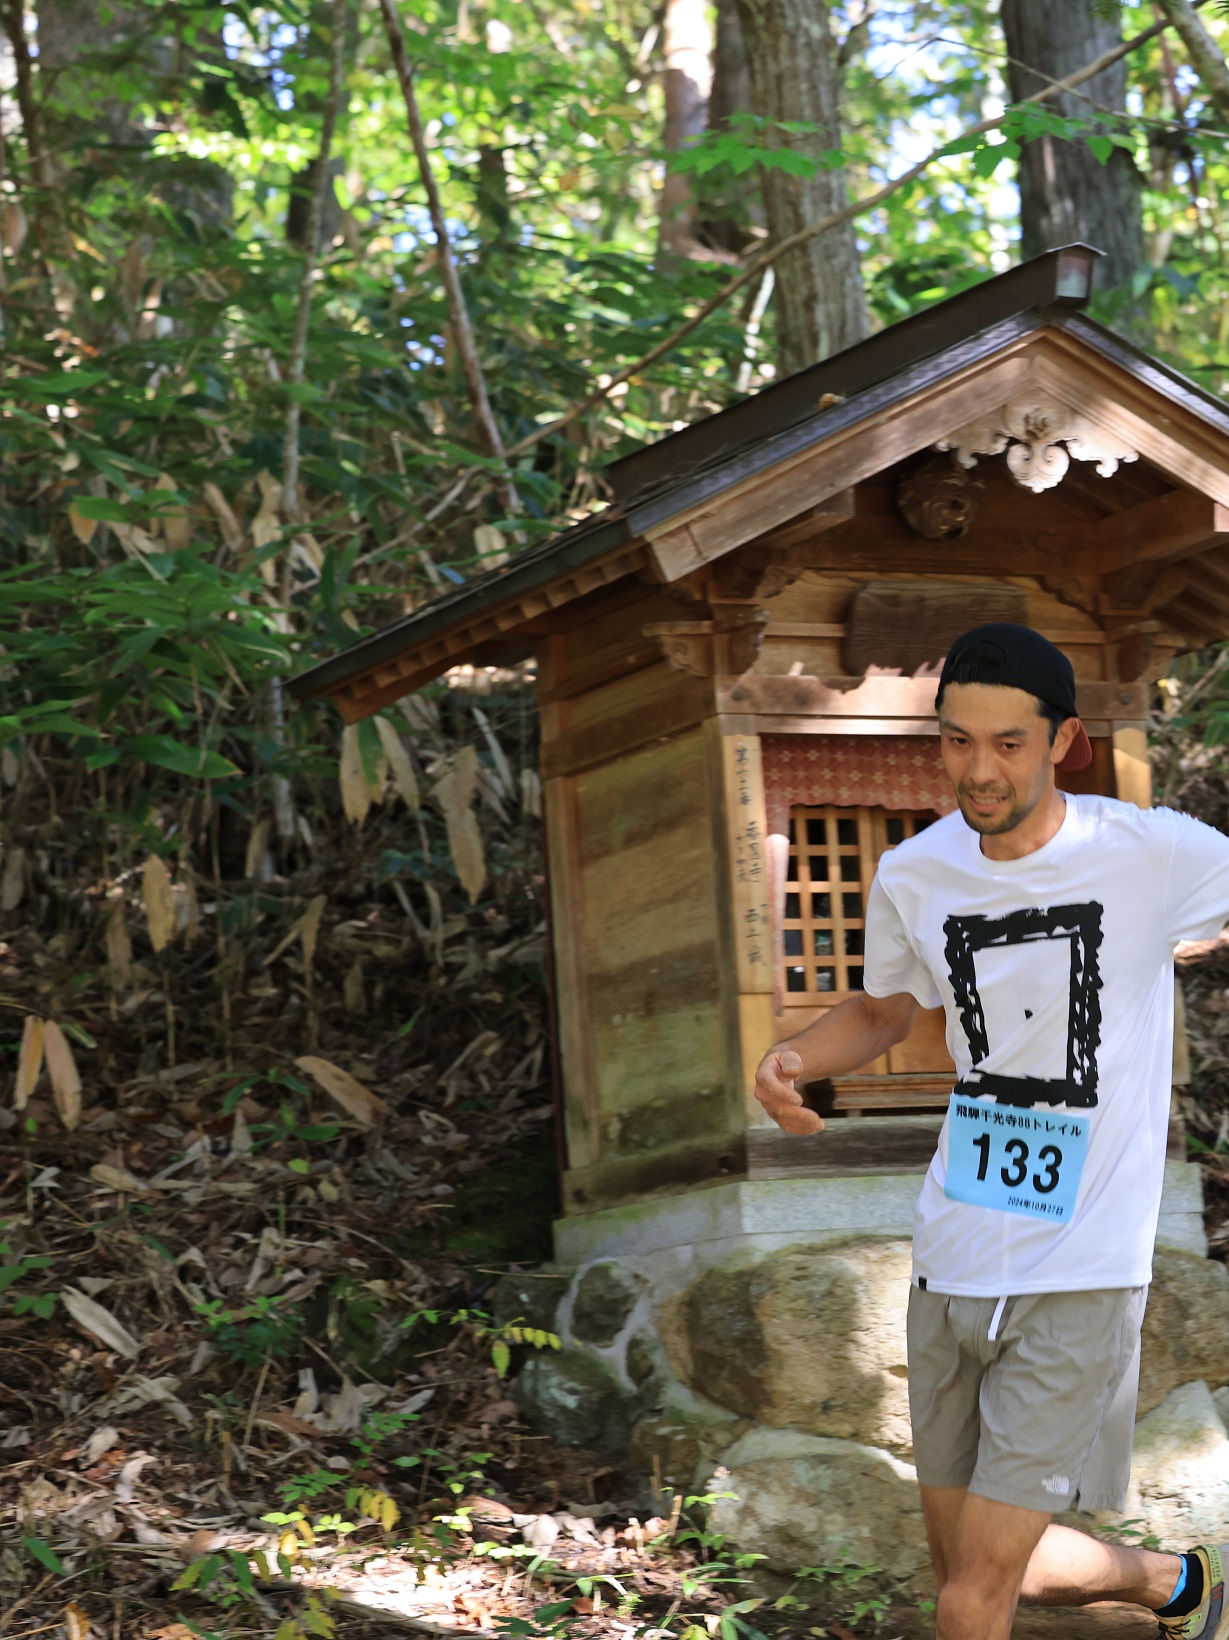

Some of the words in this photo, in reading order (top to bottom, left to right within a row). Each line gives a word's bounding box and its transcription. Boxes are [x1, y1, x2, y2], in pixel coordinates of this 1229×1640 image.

[955, 1104, 1082, 1138] 飛騨千光寺88トレイル
[972, 1132, 1063, 1194] 133
